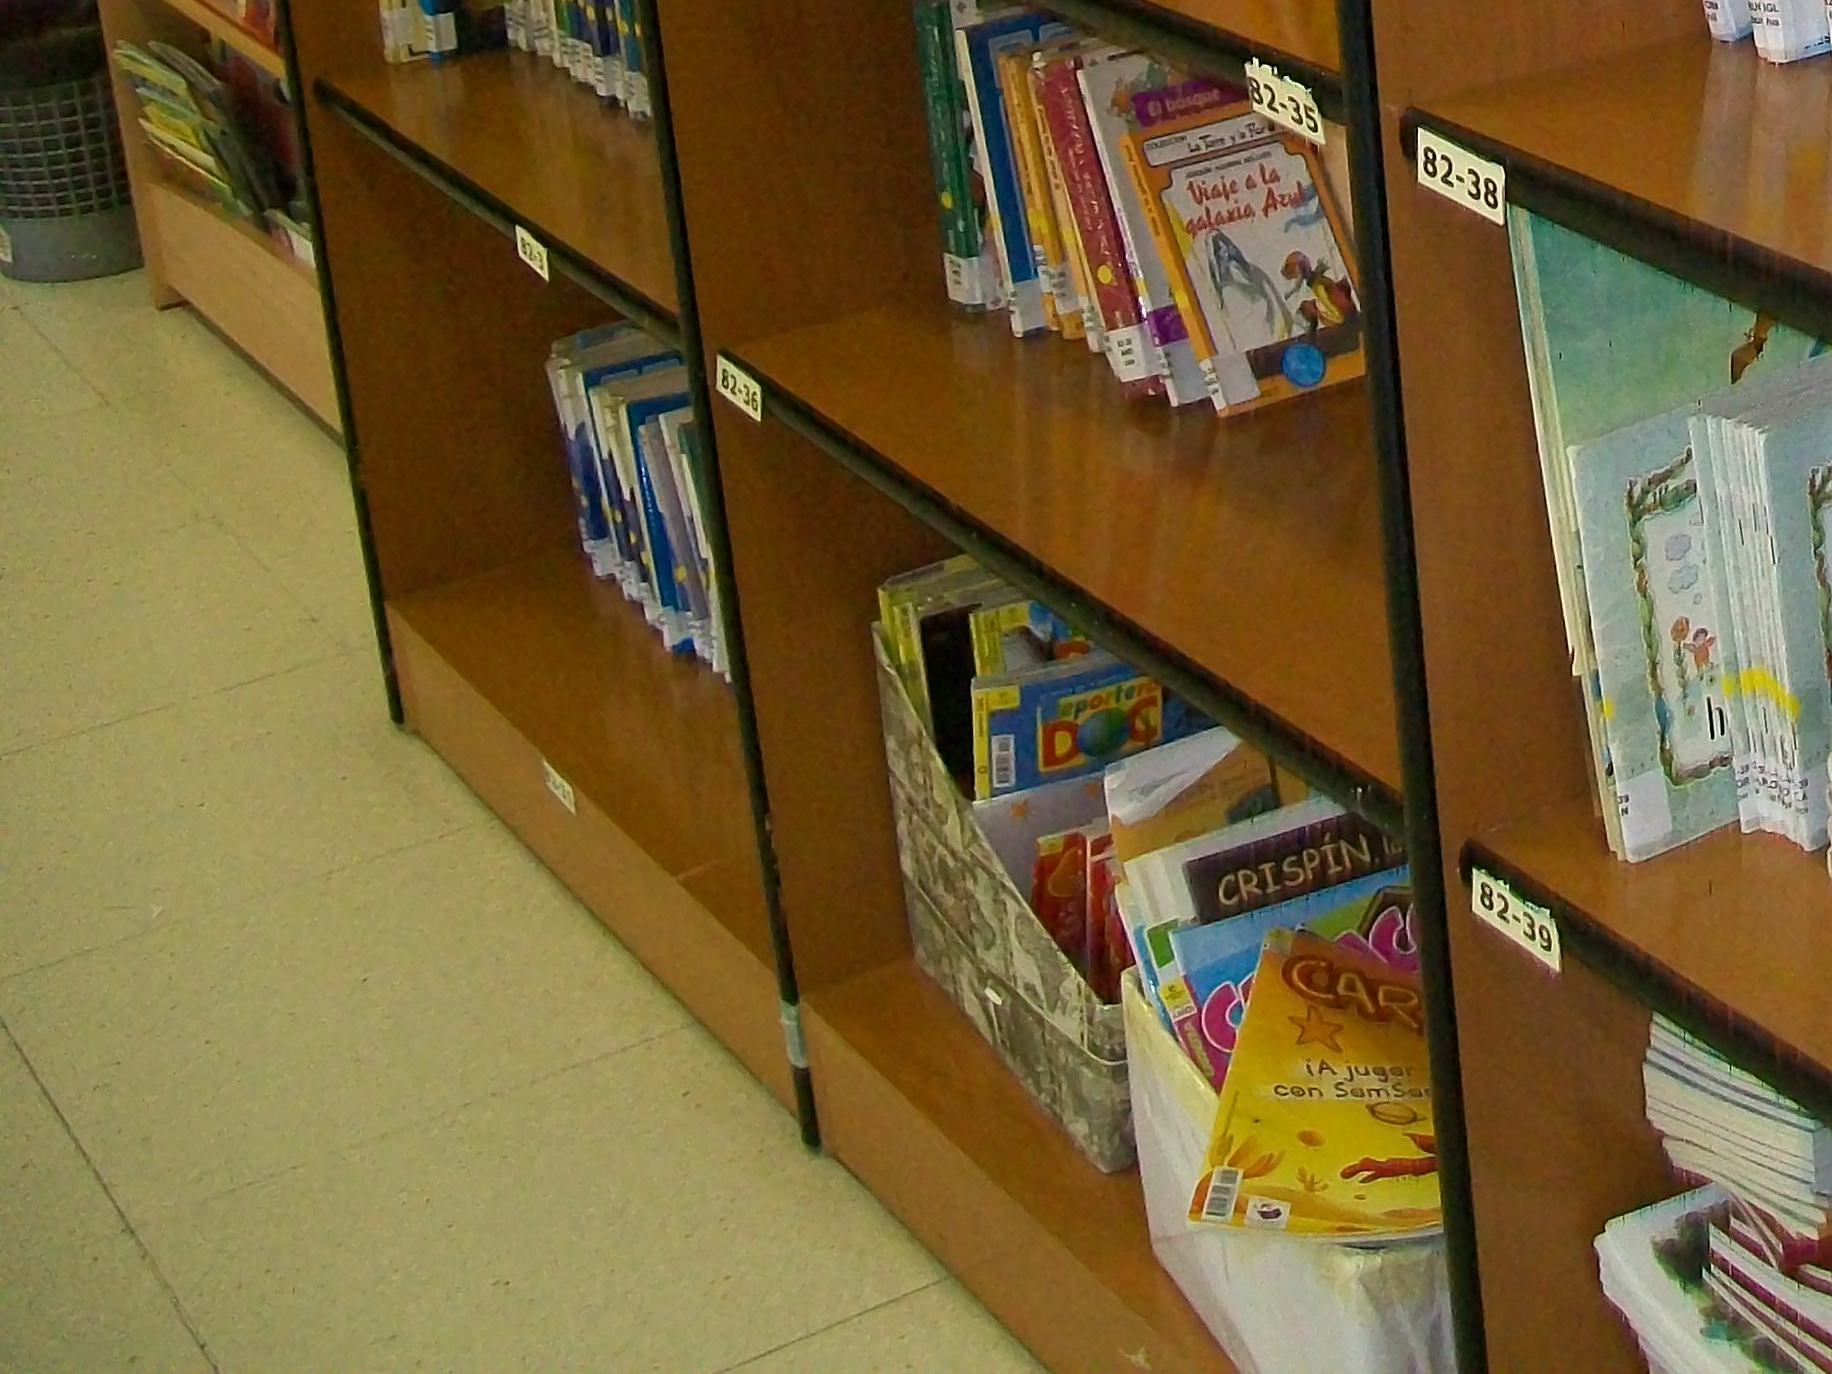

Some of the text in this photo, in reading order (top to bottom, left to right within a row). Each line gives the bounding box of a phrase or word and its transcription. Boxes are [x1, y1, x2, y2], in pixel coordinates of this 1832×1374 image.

[1249, 76, 1319, 134] 82-35
[1422, 145, 1499, 210] 82-38
[1262, 181, 1305, 218] Azul
[722, 371, 760, 413] 82-36
[1480, 882, 1553, 953] 82-39
[1273, 1080, 1431, 1100] con SamSa
[1342, 1060, 1414, 1084] jugar
